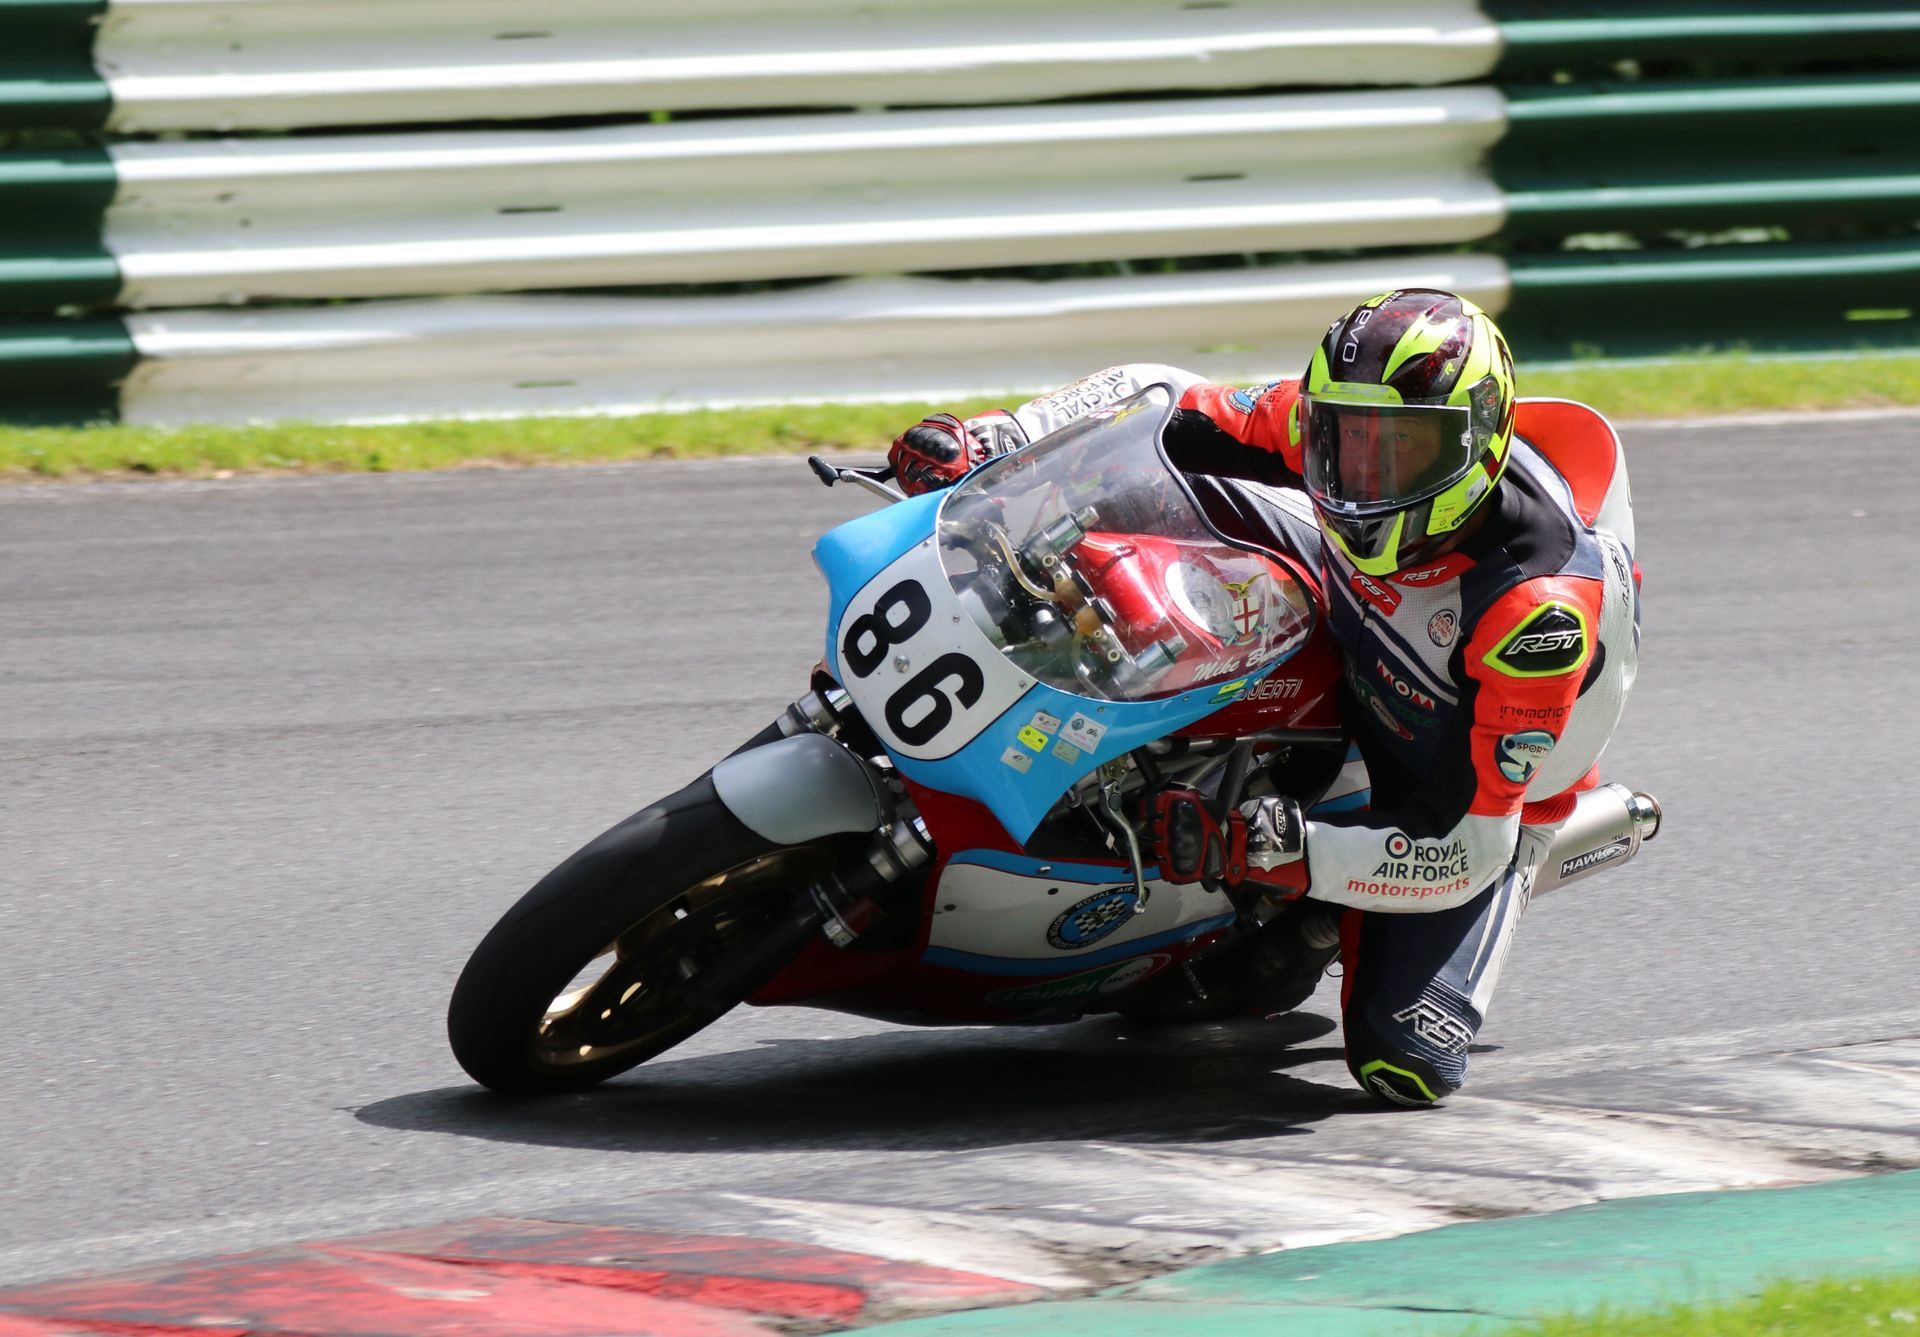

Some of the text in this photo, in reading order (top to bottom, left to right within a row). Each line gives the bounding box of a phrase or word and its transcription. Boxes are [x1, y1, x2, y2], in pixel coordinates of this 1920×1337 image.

[1402, 566, 1448, 582] RST
[1352, 574, 1397, 607] RST
[1506, 629, 1582, 655] RST
[843, 579, 984, 746] 86
[1192, 655, 1241, 683] Mike
[1414, 838, 1467, 864] ROYAL
[1372, 854, 1469, 882] AIR FORCE
[1075, 890, 1111, 909] ROYAL
[1347, 877, 1470, 899] motorsports
